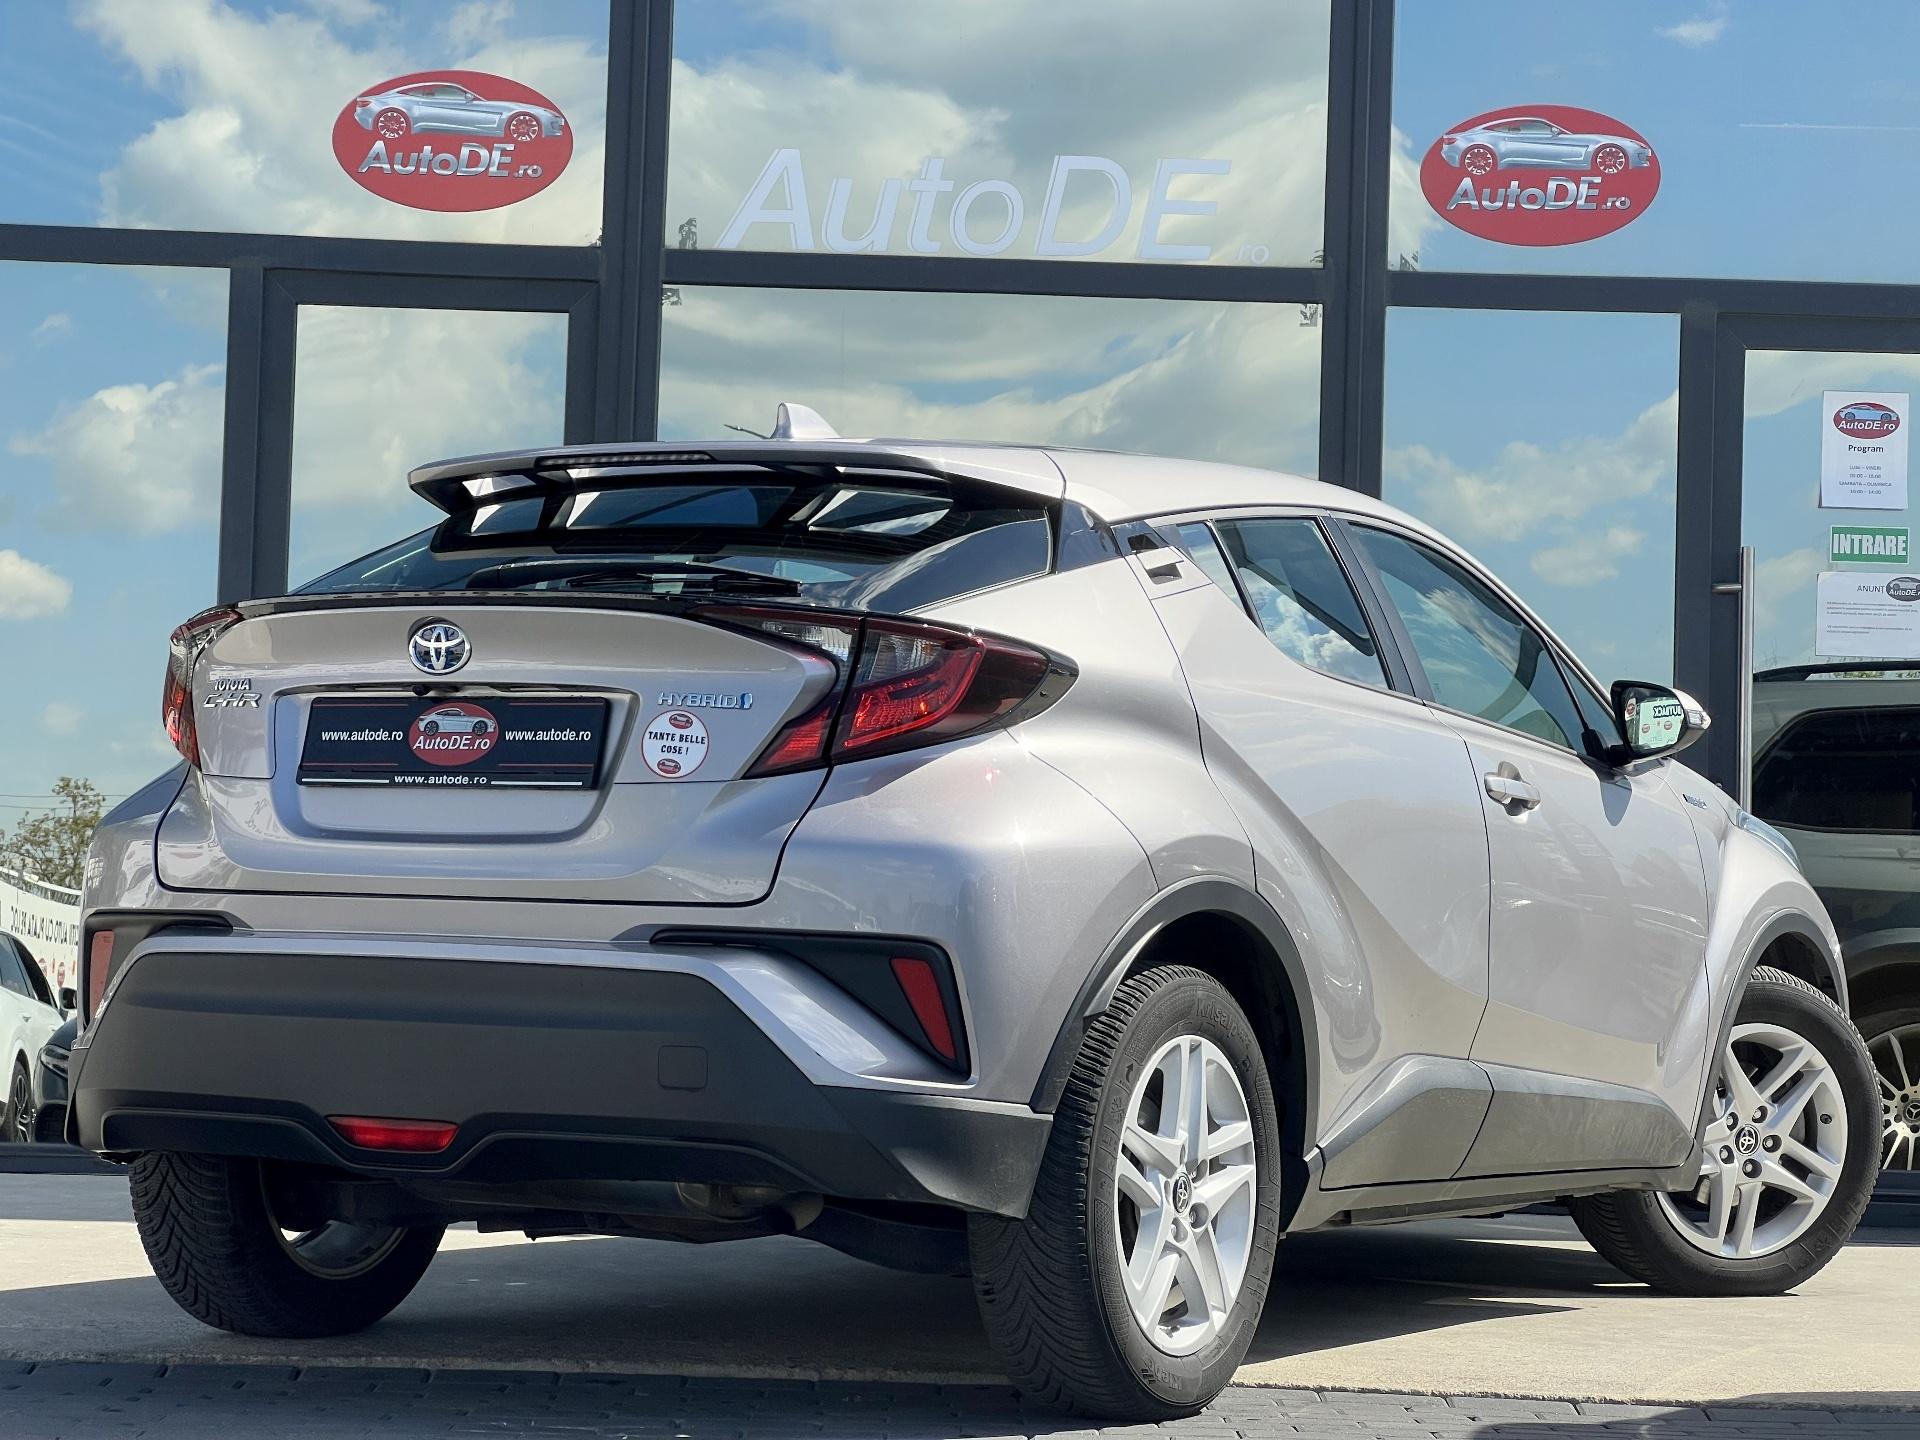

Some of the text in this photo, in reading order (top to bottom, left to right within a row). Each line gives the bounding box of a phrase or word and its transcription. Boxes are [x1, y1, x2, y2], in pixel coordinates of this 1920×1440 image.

[357, 140, 544, 178] AutoDE.ro
[1446, 176, 1632, 211] AutoDE.ro
[1838, 420, 1896, 430] AutoDE.ro
[1848, 444, 1884, 454] Program
[1832, 533, 1907, 556] INTRARE
[214, 678, 251, 691] TOYOTA
[657, 691, 740, 709] HYBRID
[321, 729, 404, 742] www.autode.ro
[504, 728, 592, 742] www.autode.ro
[648, 730, 706, 745] TANTE BELLE
[412, 735, 491, 751] AutoDE.ro
[660, 744, 683, 755] COSE
[393, 773, 488, 786] www.autode.ro
